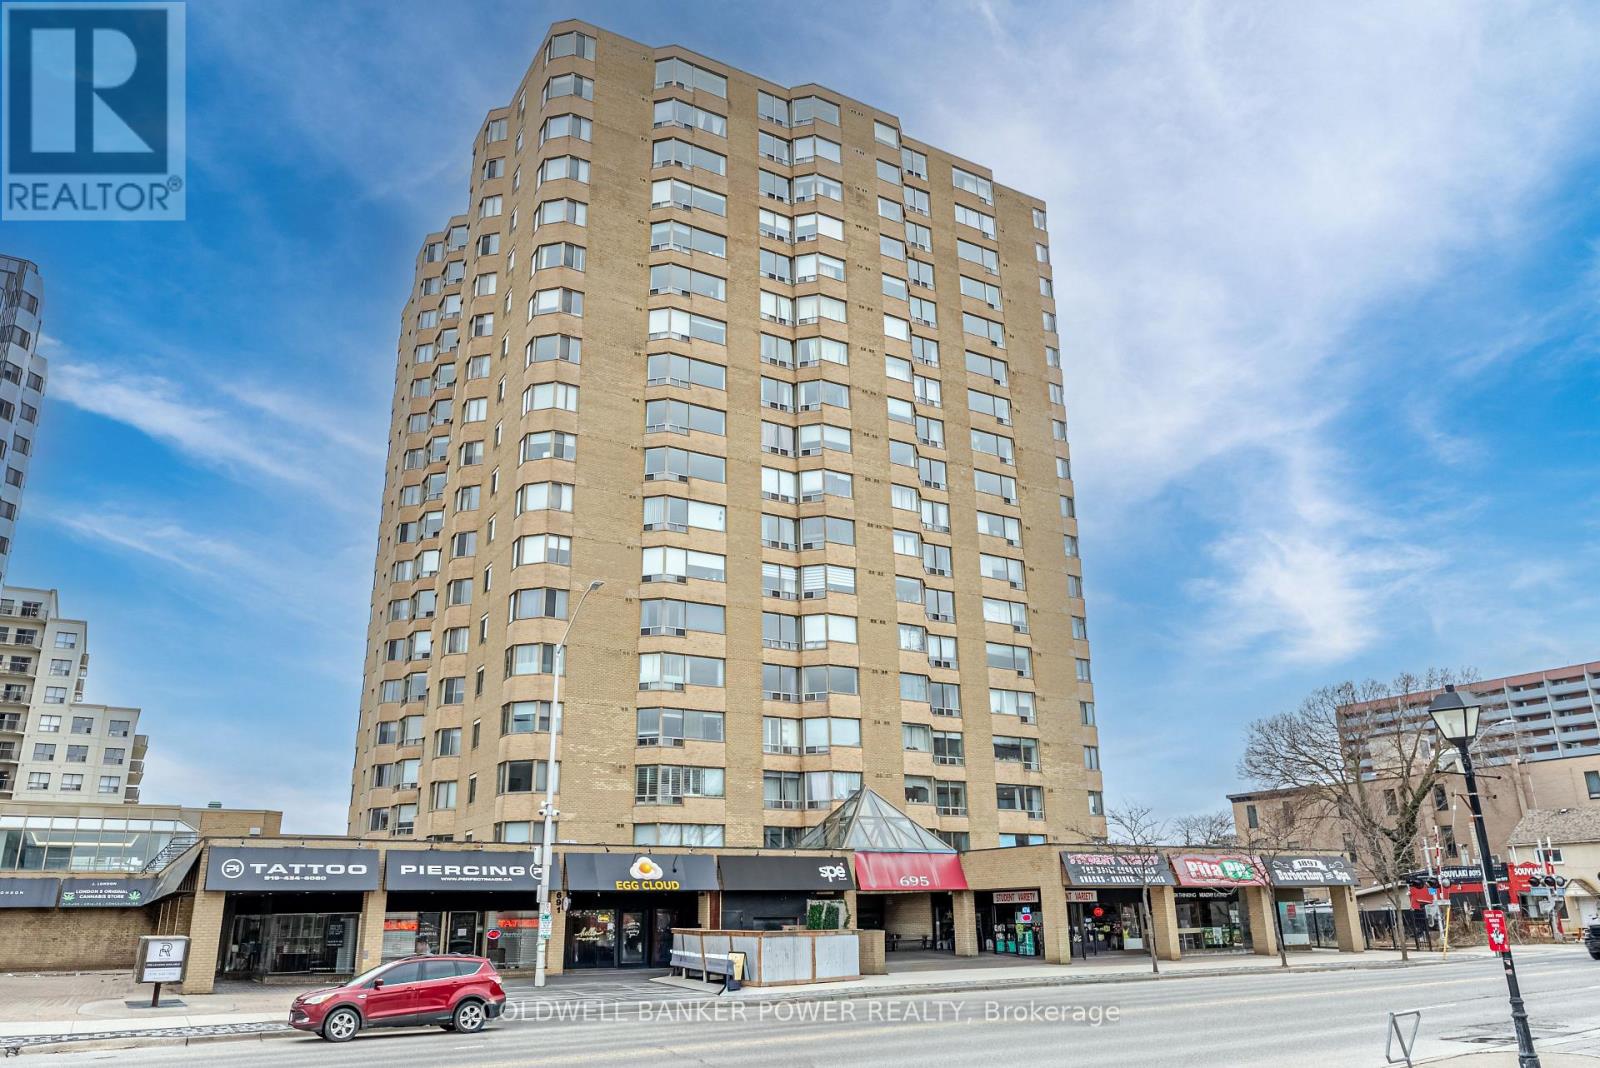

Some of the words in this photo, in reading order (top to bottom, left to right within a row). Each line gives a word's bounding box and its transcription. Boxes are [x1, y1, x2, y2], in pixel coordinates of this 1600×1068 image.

[250, 863, 368, 875] TATTOO
[400, 865, 526, 876] PIERCING
[1185, 860, 1224, 878] Pita
[1440, 868, 1468, 877] SOUVLAKI
[1468, 869, 1482, 877] BOYS
[899, 876, 930, 887] 695
[1275, 870, 1324, 883] Barbershop
[1333, 869, 1352, 883] Spa
[615, 881, 640, 890] EGG
[641, 881, 680, 890] CLOUD
